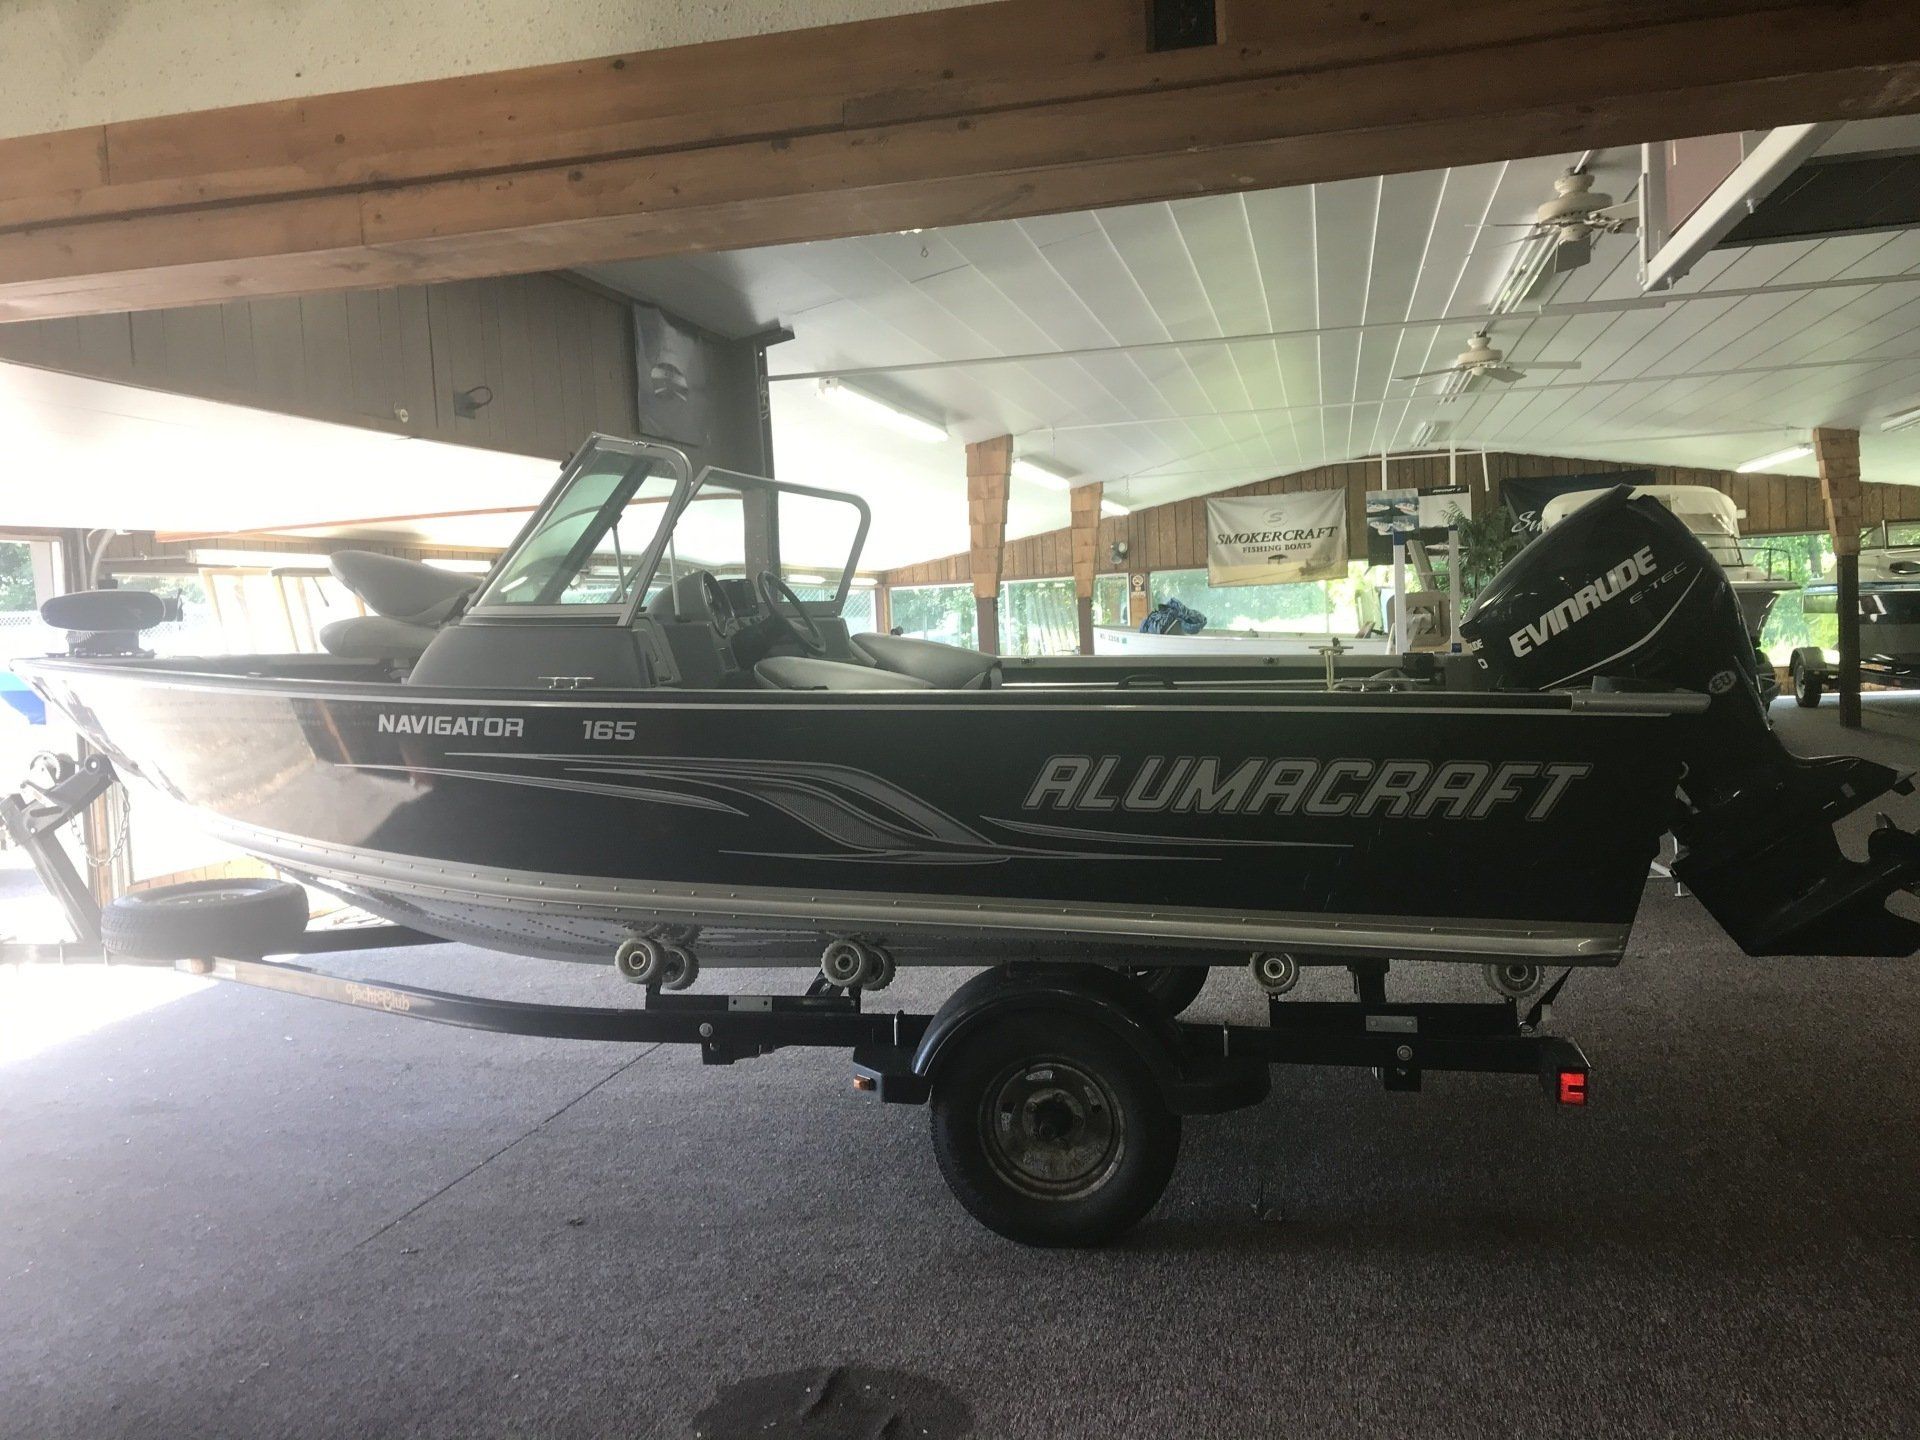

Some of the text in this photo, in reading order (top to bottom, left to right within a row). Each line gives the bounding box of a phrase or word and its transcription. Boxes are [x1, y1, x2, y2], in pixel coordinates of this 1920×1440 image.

[1216, 526, 1339, 545] SMOKERCRAFT
[1242, 542, 1312, 554] FISHING BOATS
[1629, 561, 1687, 605] E-TEC
[1508, 545, 1658, 658] EVINRUDE
[377, 714, 637, 741] NAVIGATOR 165
[1021, 755, 1595, 822] ALUMACRAFT
